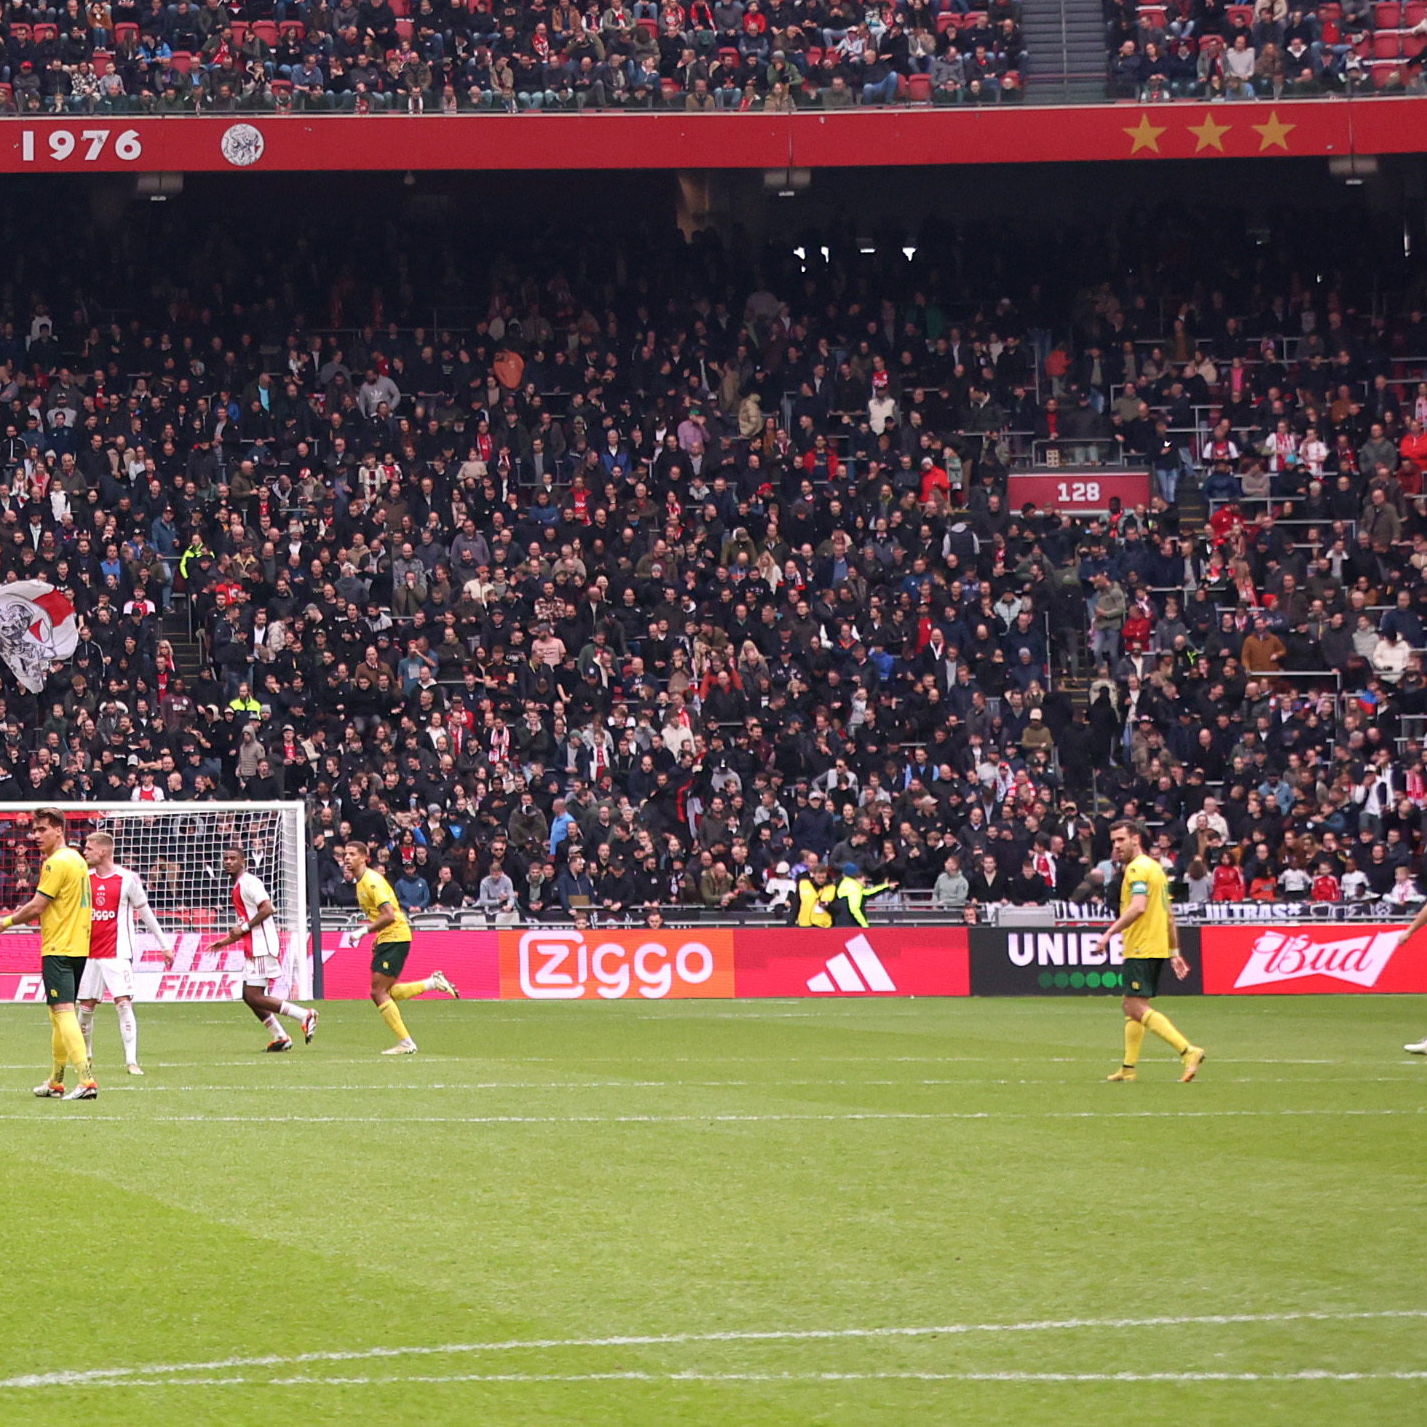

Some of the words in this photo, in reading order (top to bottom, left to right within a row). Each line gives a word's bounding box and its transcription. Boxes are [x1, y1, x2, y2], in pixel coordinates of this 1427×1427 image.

[22, 129, 143, 162] 1976
[1057, 482, 1101, 503] 128
[1008, 933, 1125, 967] UNIBE
[1251, 933, 1373, 975] Bud
[155, 974, 238, 1000] Flink
